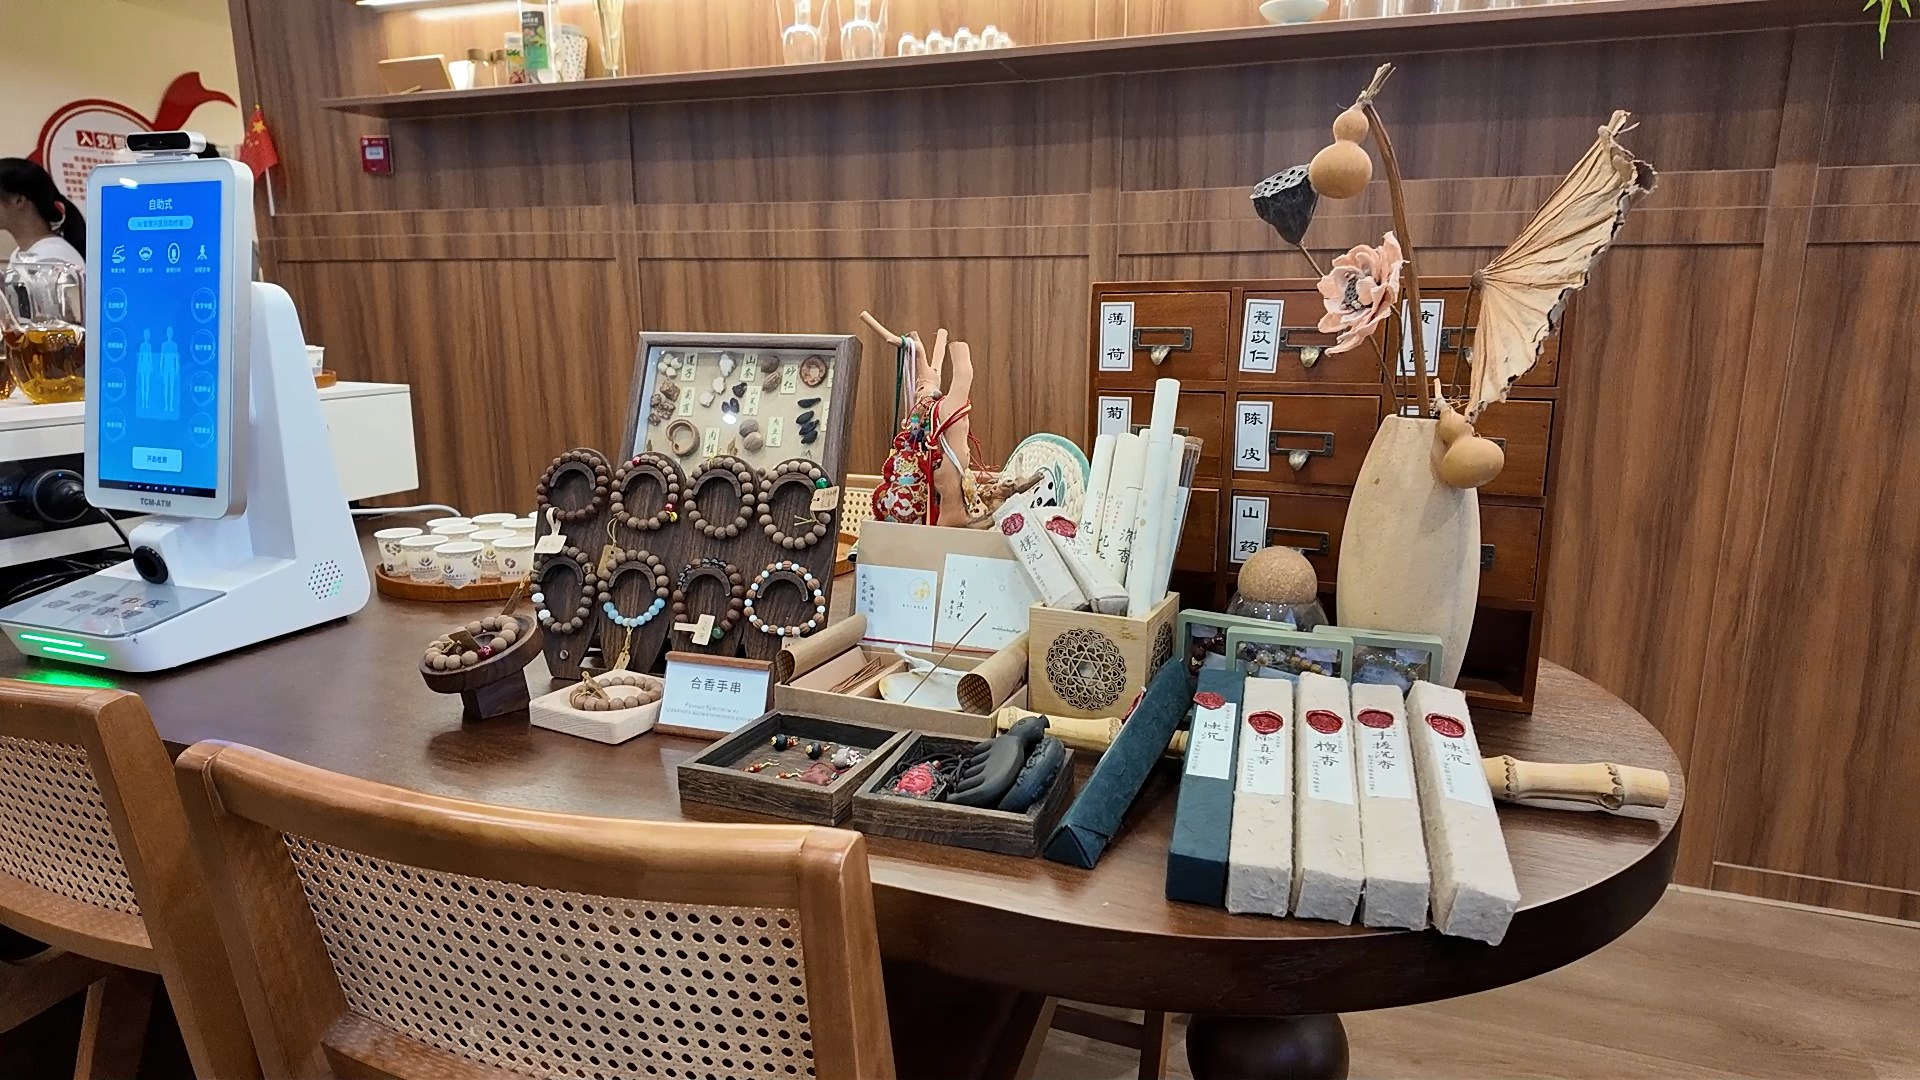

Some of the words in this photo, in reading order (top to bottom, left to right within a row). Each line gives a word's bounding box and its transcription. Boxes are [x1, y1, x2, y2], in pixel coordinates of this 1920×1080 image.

[148, 198, 173, 210] 自助式
[1107, 312, 1126, 361] 薄荷
[1249, 310, 1273, 363] 薏苡仁
[1241, 412, 1264, 462] 陈皮
[140, 497, 172, 508] TCM-ATM
[1240, 506, 1260, 553] 山药
[690, 676, 742, 695] 合香手串
